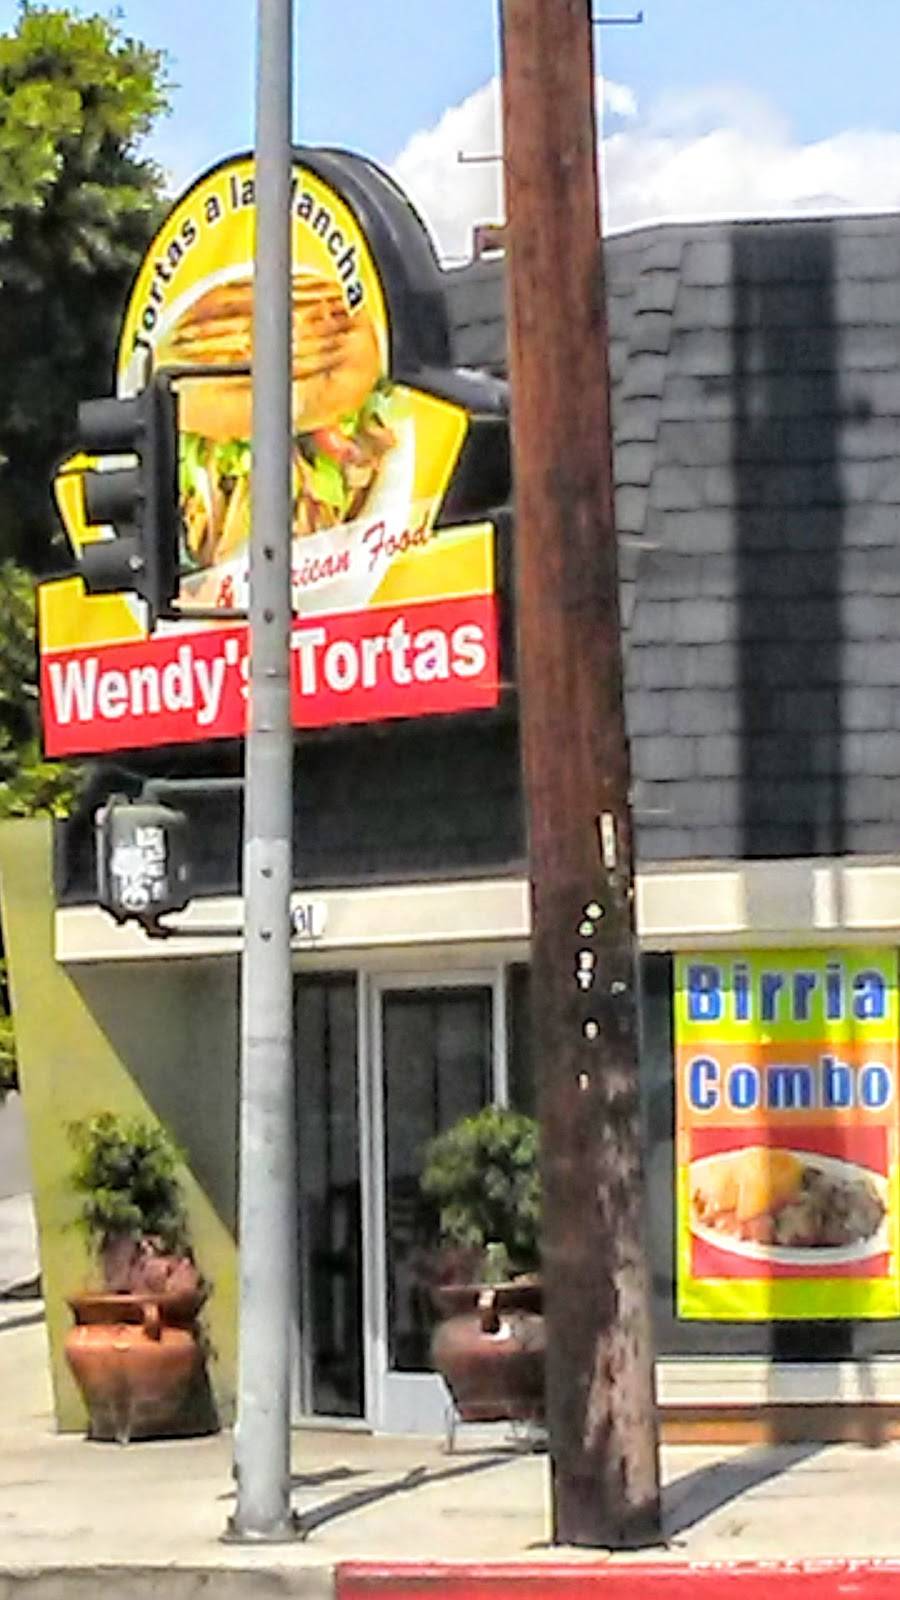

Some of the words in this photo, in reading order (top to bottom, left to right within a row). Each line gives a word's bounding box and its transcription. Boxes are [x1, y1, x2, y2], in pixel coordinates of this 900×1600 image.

[133, 218, 197, 352] Tortas
[204, 195, 221, 223] a
[362, 511, 429, 572] Food
[290, 617, 487, 696] Tortas
[685, 962, 887, 1023] Birria
[686, 1054, 893, 1112] Combo
